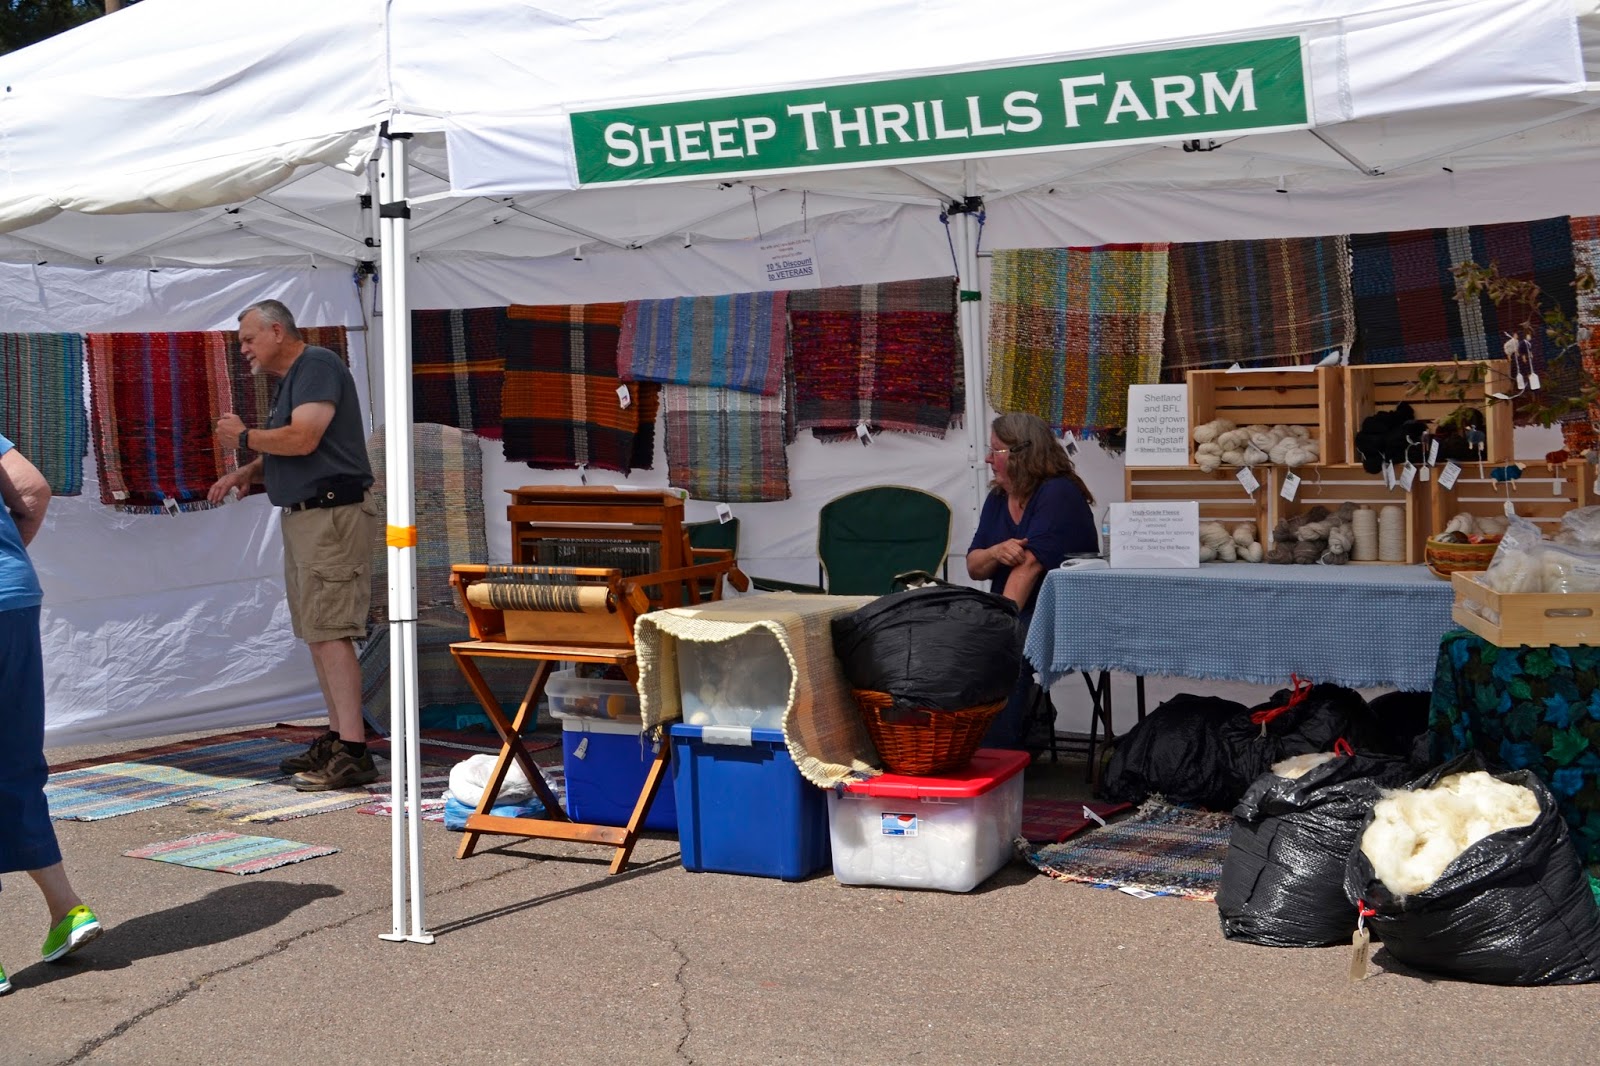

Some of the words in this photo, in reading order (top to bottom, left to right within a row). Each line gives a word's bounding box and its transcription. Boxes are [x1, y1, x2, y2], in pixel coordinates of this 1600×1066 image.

[604, 116, 777, 167] SHEEP
[787, 90, 1043, 152] THRILLS
[1060, 68, 1258, 128] FARM
[766, 263, 775, 271] 10
[782, 257, 812, 268] Discount
[776, 266, 813, 279] VETERANS
[1144, 394, 1181, 402] Shetland
[1144, 405, 1160, 413] and
[1163, 404, 1180, 413] BFL
[1137, 415, 1157, 423] wool
[1160, 416, 1186, 425] grown
[1137, 426, 1163, 435] locally
[1166, 426, 1185, 434] here
[1137, 436, 1145, 444] in
[1147, 436, 1184, 445] Flagstaff
